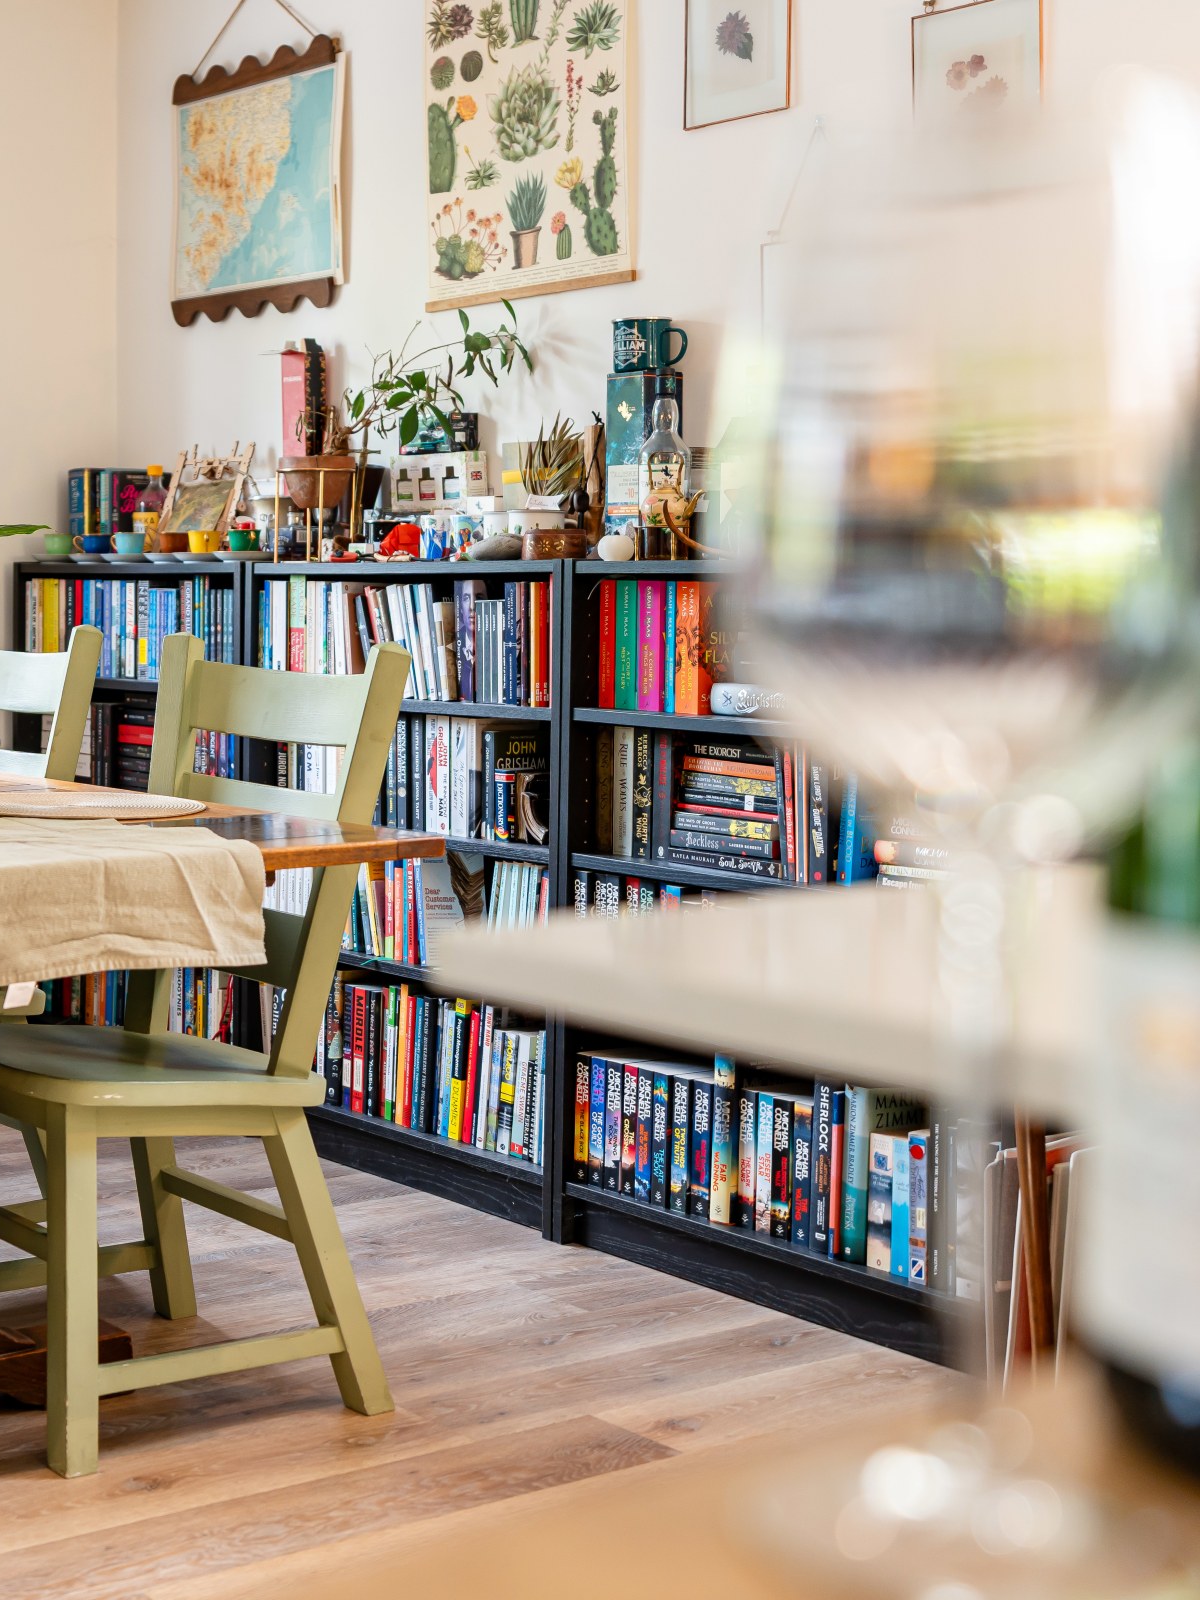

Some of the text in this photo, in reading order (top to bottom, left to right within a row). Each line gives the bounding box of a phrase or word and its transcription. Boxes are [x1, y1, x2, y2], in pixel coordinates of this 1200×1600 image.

[278, 752, 286, 774] JUROR
[496, 757, 546, 770] GRISHAM
[507, 741, 537, 755] JOHN
[694, 744, 708, 755] THE
[708, 745, 741, 758] EXORCIST
[618, 743, 628, 812] RULE WOLVES
[685, 832, 719, 850] Reckless
[813, 809, 824, 854] GUIDE DATING
[845, 830, 853, 863] BLOOD
[691, 855, 715, 864] MAURAIS
[425, 888, 441, 896] Dear
[882, 878, 908, 890] Escape
[355, 995, 363, 1052] MURDLE
[504, 1036, 513, 1080] MONACO
[591, 1064, 599, 1107] CONNELLY
[607, 1068, 615, 1111] CONNELLY
[451, 1086, 459, 1126] DUMMIES
[592, 1112, 597, 1122] OF
[714, 1097, 722, 1145] CONNELLY
[722, 1101, 730, 1143] MICHAEL
[819, 1085, 829, 1152] SHERLOCK
[674, 1128, 680, 1139] OF
[774, 1107, 782, 1152] CONNELLY
[781, 1111, 789, 1150] MICHAEL
